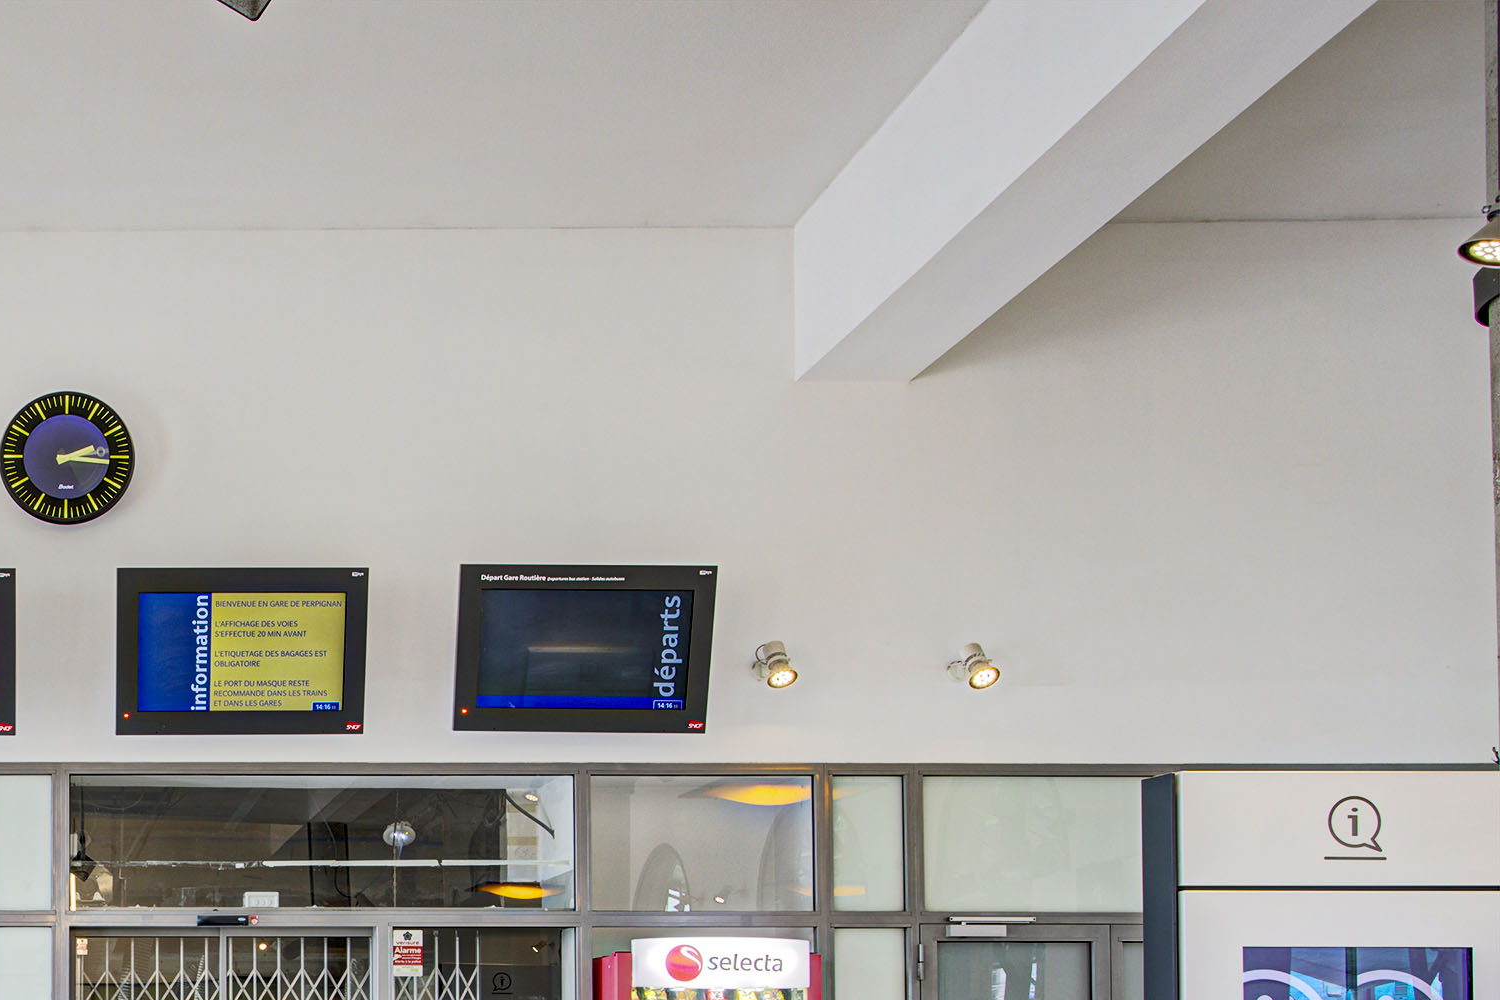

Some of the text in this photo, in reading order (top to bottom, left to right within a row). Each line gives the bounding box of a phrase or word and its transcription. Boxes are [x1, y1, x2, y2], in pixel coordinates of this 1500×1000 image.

[216, 600, 342, 608] BIENVENUE EN GARE DE PERPIGNAN
[191, 594, 209, 711] information
[653, 595, 682, 698] départs
[707, 951, 784, 973] selecta
